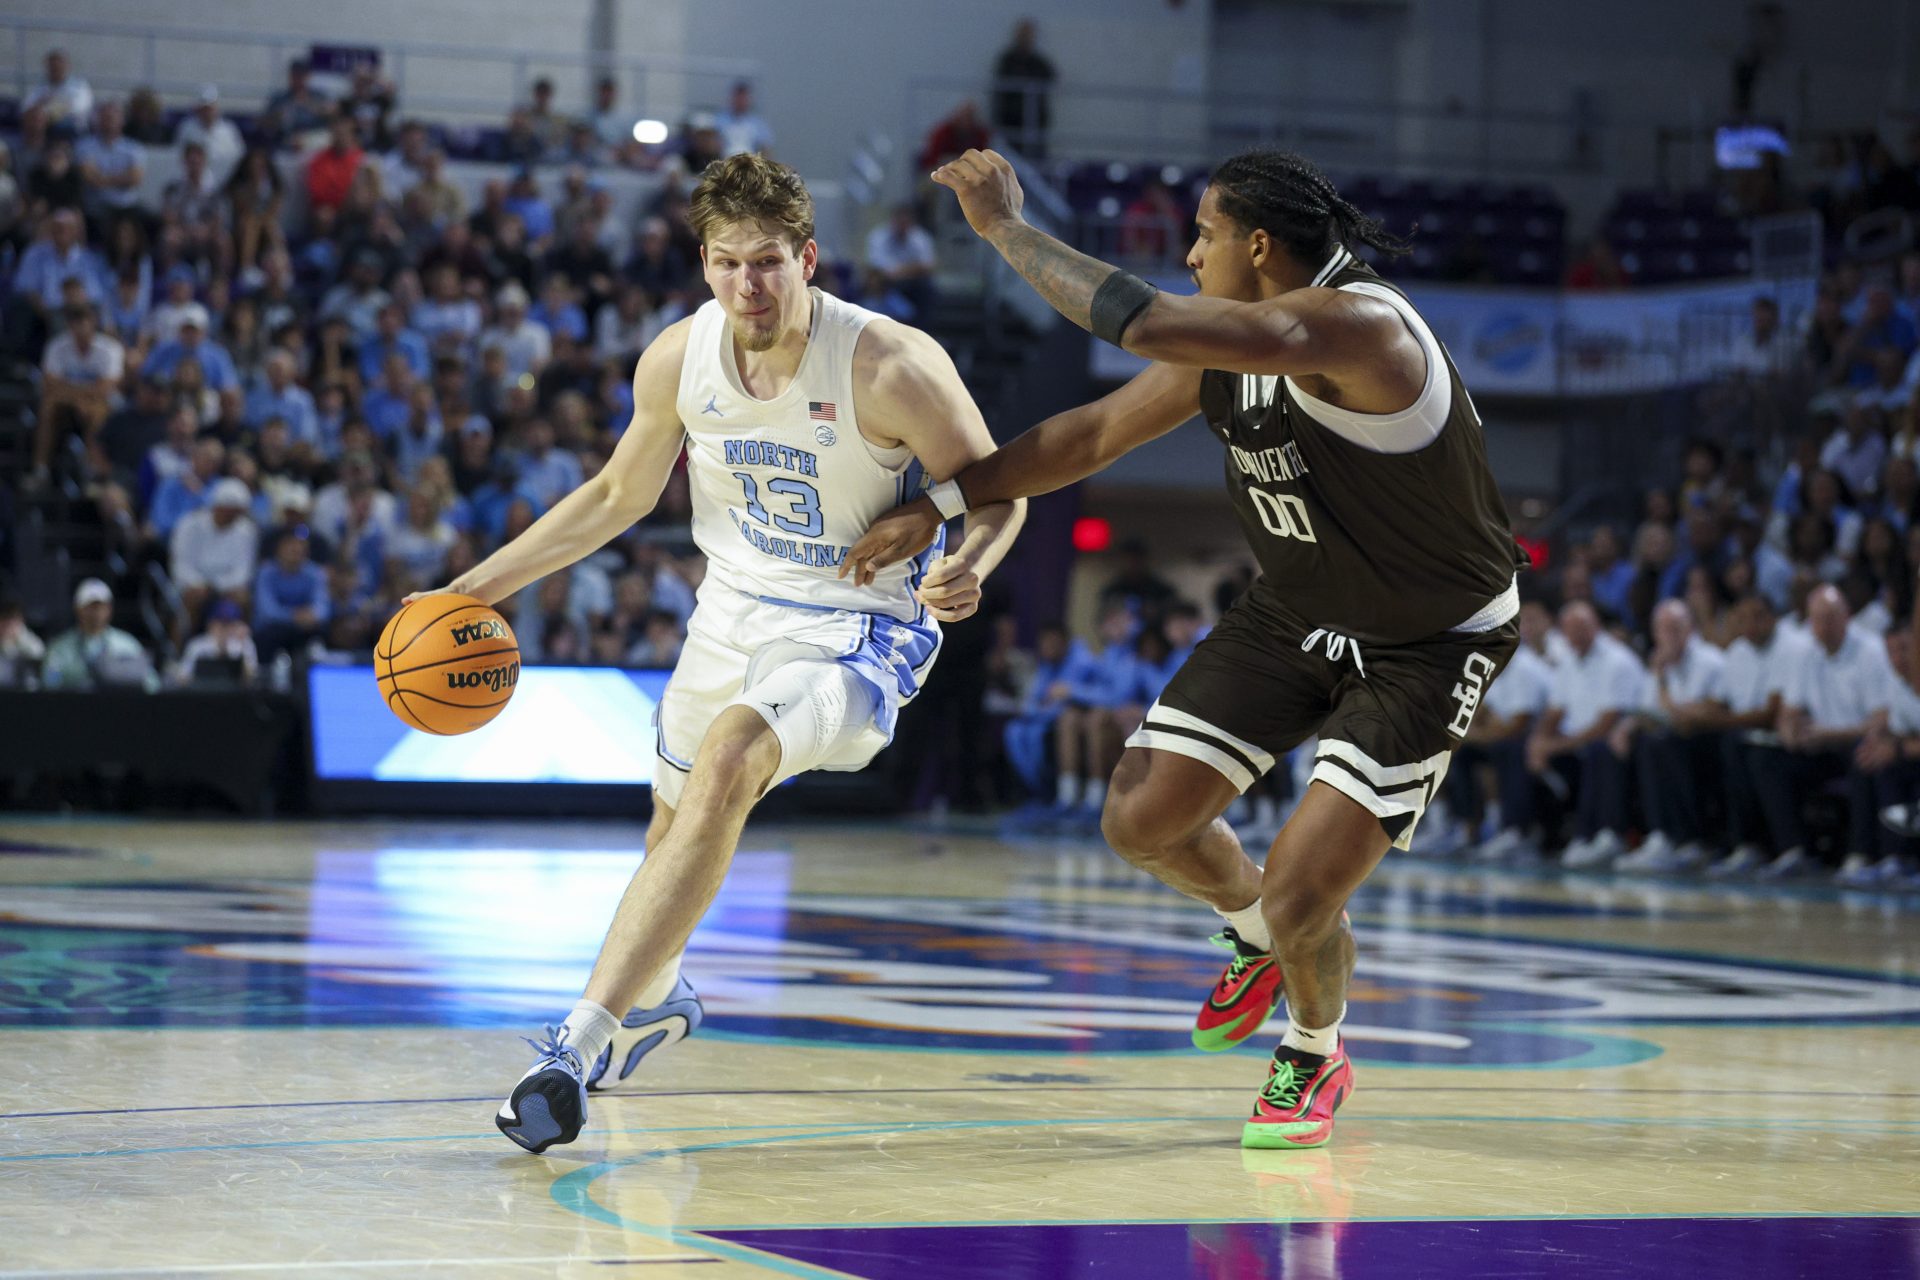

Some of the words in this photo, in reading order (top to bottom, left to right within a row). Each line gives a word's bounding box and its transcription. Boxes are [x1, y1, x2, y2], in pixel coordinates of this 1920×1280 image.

[724, 439, 819, 479] NORTH
[732, 472, 824, 539] 13
[1247, 486, 1318, 544] 00
[450, 619, 509, 647] NCAA
[446, 660, 520, 693] Wilson
